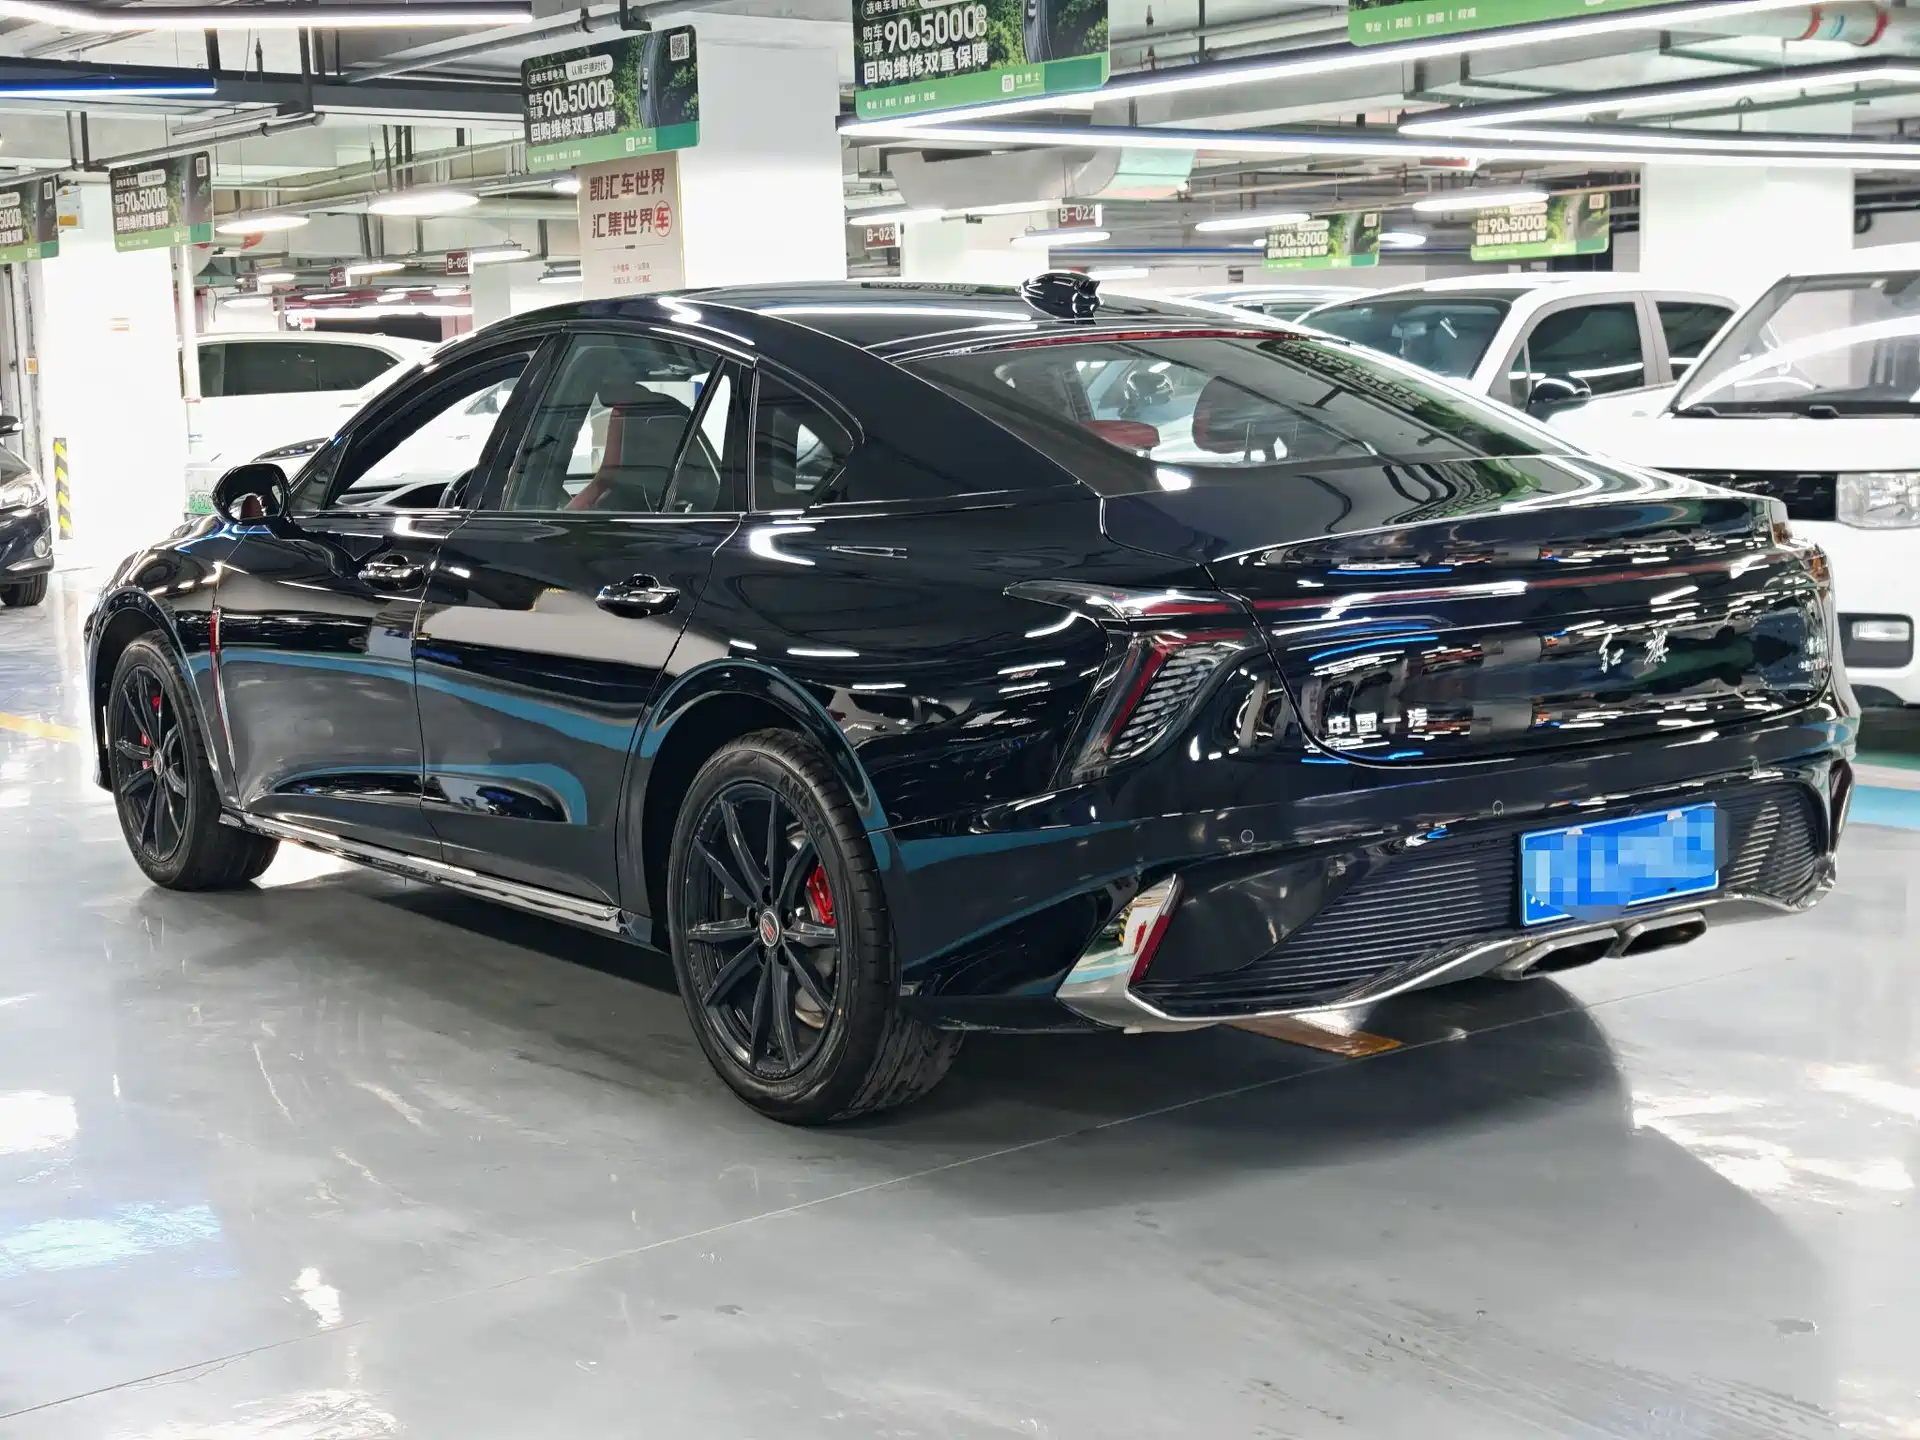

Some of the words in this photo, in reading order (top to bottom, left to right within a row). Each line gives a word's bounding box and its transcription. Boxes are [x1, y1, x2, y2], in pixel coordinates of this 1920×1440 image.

[863, 24, 883, 41] 购车
[863, 40, 883, 57] 可享
[863, 42, 988, 85] 回购维修双重保障
[530, 109, 616, 143] 回购维修双重保障
[589, 167, 665, 201] 凯汇车世界
[592, 206, 670, 238] 汇集世界车
[1060, 205, 1096, 222] B-022
[866, 227, 895, 242] B-023
[1328, 708, 1427, 734] 中国一汽
